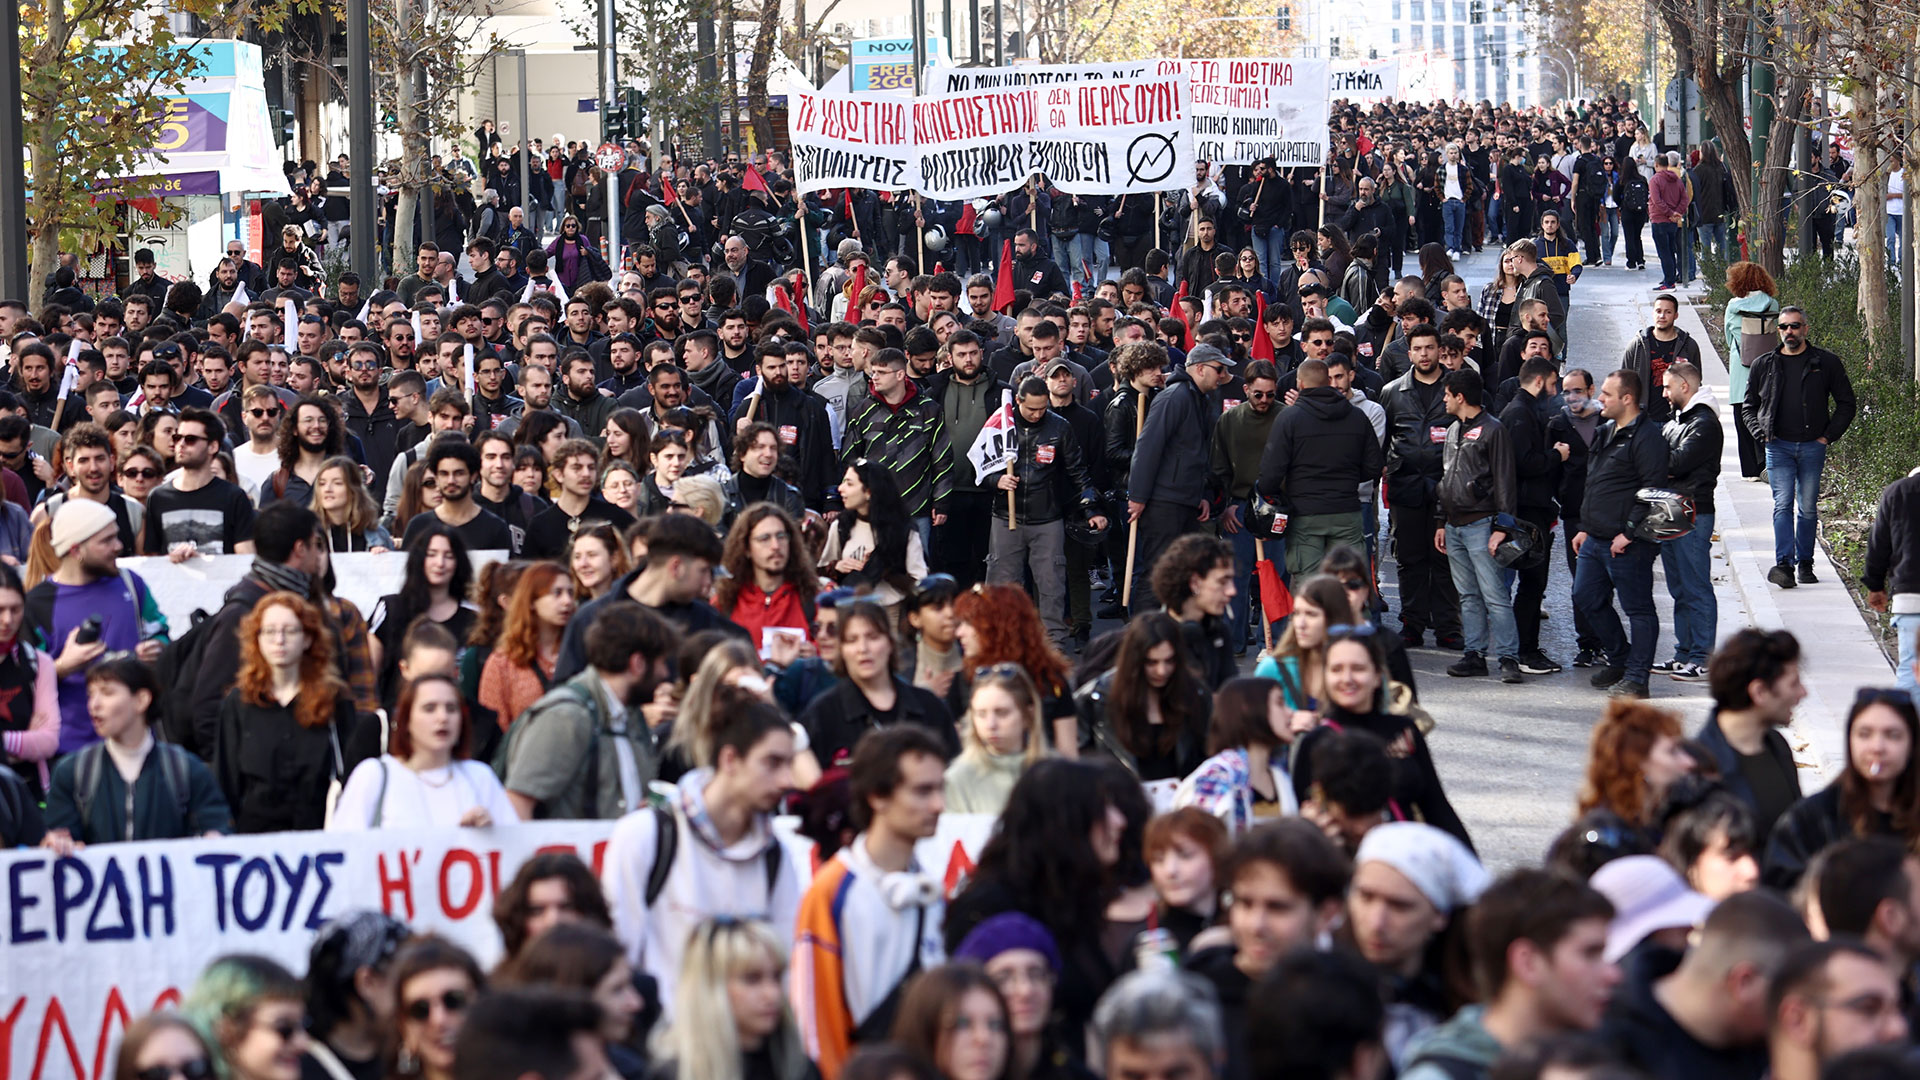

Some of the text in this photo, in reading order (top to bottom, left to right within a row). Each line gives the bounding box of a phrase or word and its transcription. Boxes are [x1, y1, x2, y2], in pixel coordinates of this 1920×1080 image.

[1190, 61, 1219, 83] ΣΤΑ
[1230, 61, 1293, 86] ΙΔΙΩΤΙΚΑ
[796, 81, 1181, 146] ΤΑ ΙΔΙΩΤΙΚΑ ΠΑΝΕΠΙΣΤΗΜΙΑ ΔΕΝ ΘΑ ΠΕΡΑΣΟΥΝ!
[921, 144, 1025, 192] ΦΟΙΤΗΤΙΚΩΝ
[1029, 140, 1110, 184] ΣΥΛΛΟΓΩΝ
[0, 854, 175, 944] ΕΡΔΗ
[195, 852, 344, 932] ΤΟΥΣ
